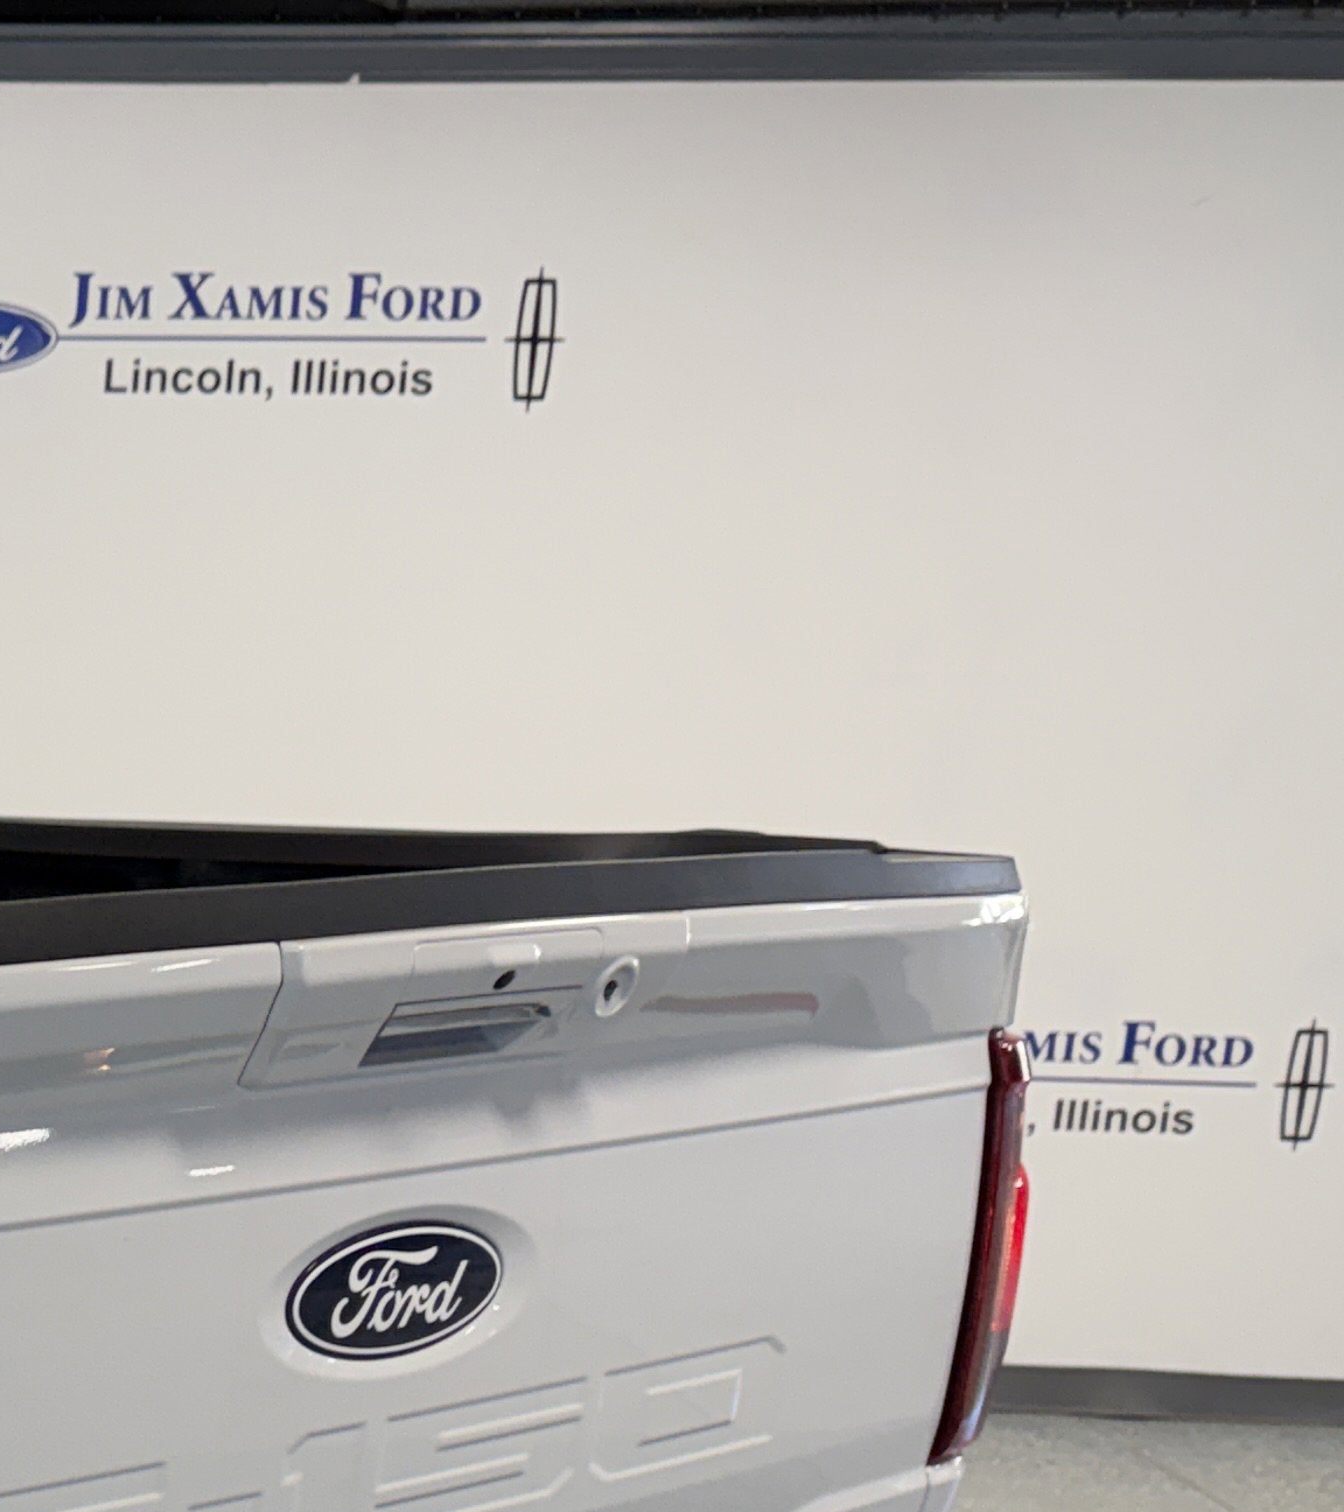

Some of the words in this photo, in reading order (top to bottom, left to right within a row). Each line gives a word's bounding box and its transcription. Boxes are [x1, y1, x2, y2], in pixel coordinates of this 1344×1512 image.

[69, 272, 153, 328] JIM
[168, 272, 329, 321] XAMIS
[346, 273, 482, 322] FORD
[104, 359, 273, 400] Lincoln,
[292, 359, 433, 396] Illinois
[1025, 1030, 1103, 1063] MIS
[1117, 1020, 1254, 1068] FORD
[1052, 1099, 1194, 1135] Illinois
[331, 1246, 468, 1338] Ford
